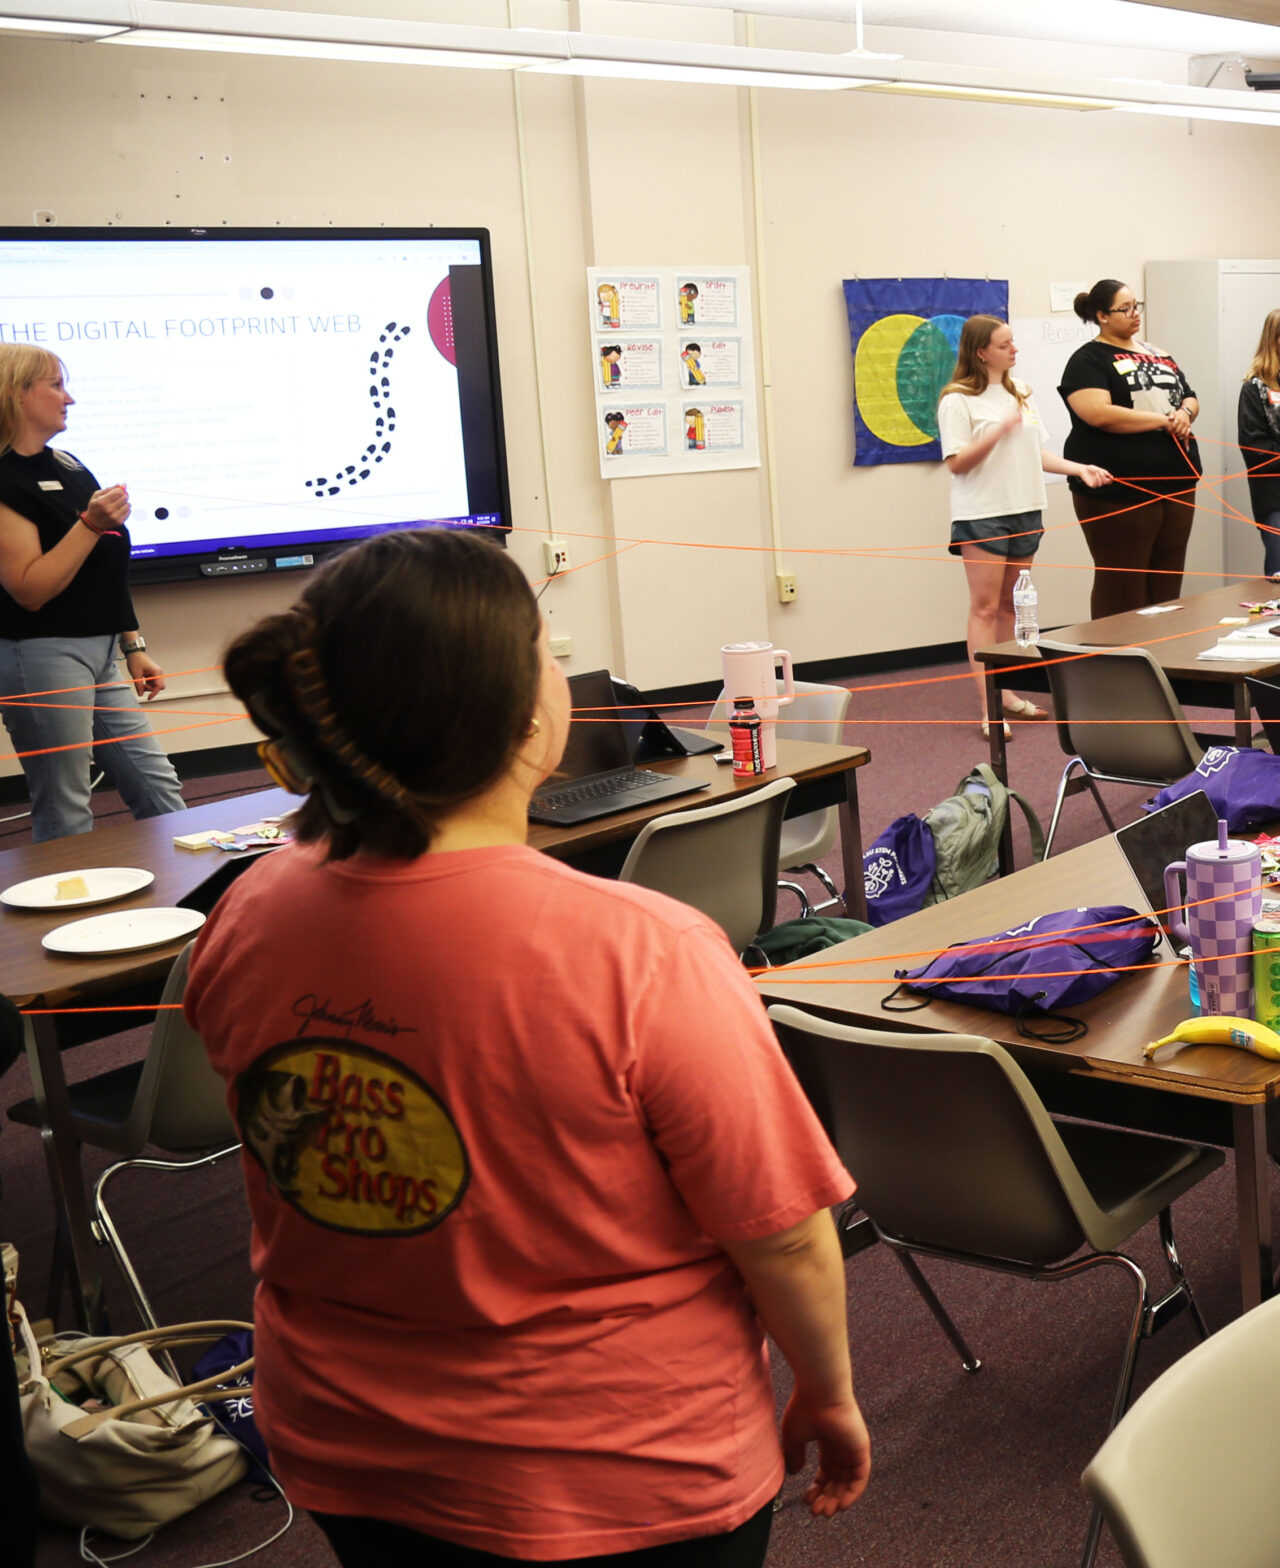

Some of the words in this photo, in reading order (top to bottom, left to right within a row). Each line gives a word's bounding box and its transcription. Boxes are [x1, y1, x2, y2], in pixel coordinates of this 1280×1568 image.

[0, 322, 48, 342] THE
[57, 320, 156, 341] DIGITAL
[164, 316, 300, 337] FOOTPRINT
[308, 314, 362, 333] WEB
[308, 1053, 405, 1120] Bass
[316, 1112, 387, 1162] Pro
[318, 1155, 438, 1221] Shops
